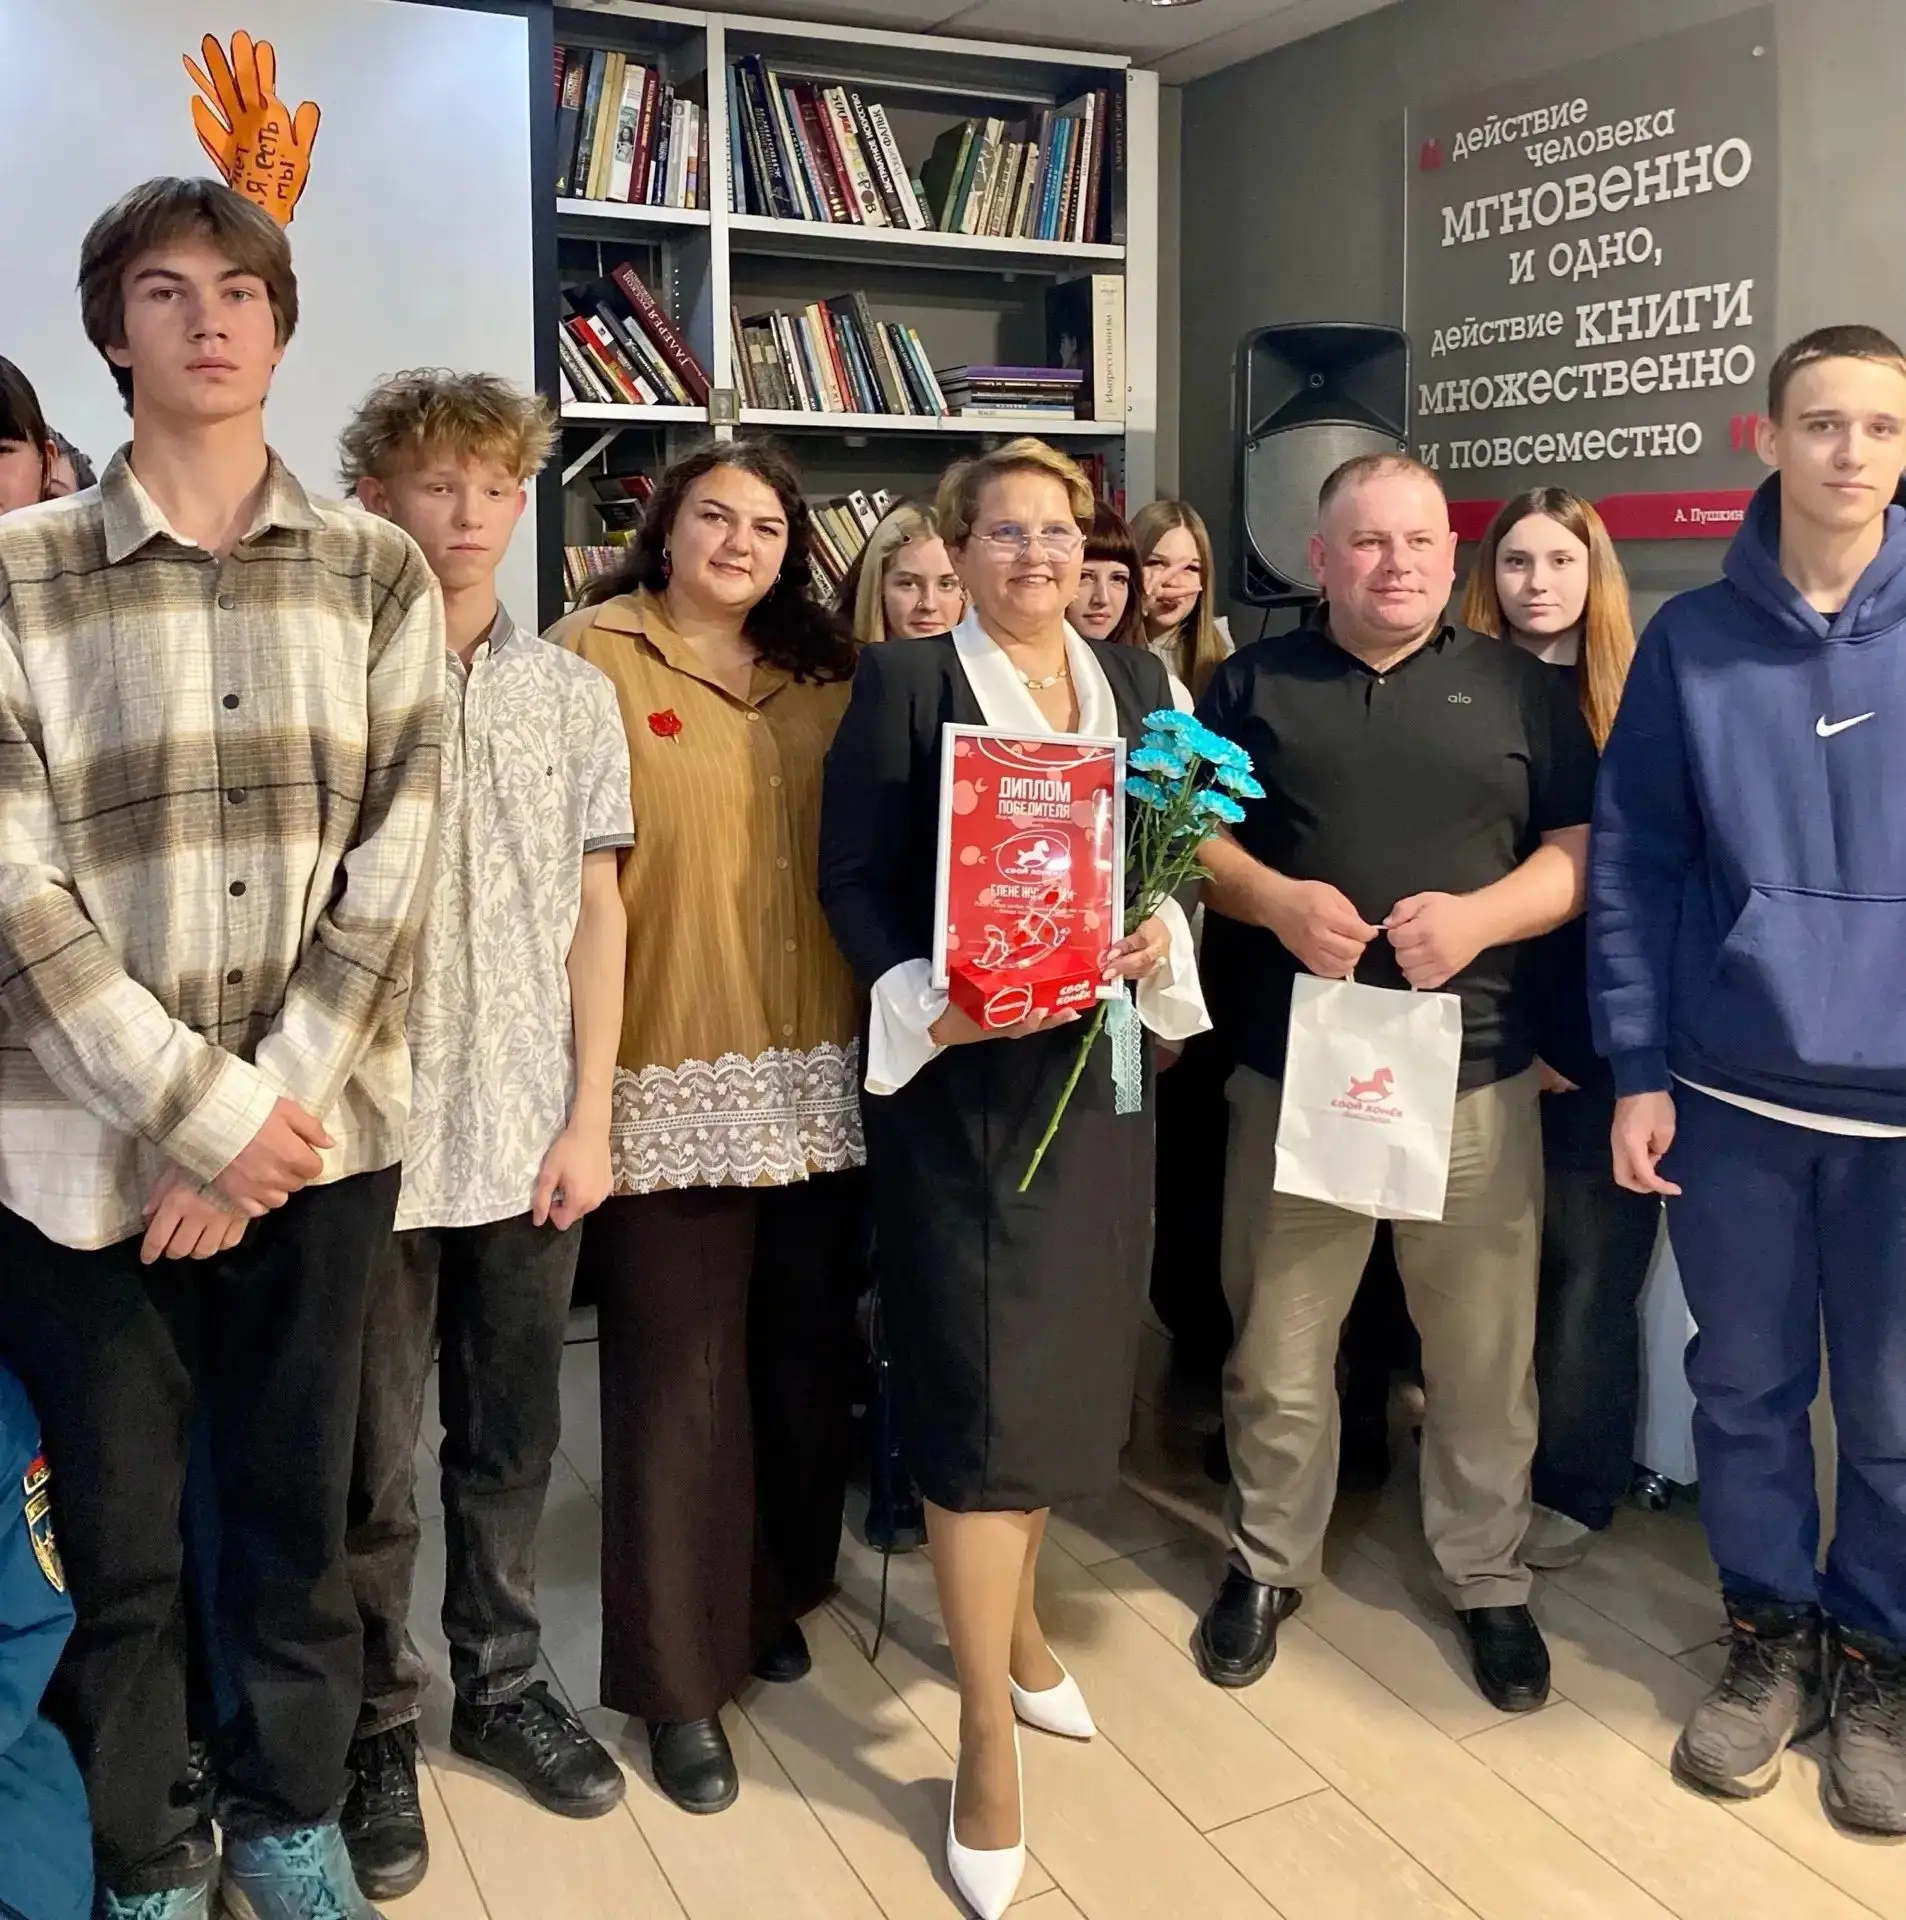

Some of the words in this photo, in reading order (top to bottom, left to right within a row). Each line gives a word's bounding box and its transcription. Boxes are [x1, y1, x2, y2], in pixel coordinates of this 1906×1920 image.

[850, 91, 874, 139] ИСКУССТВО
[870, 108, 894, 147] ФАЛЬК
[1452, 97, 1588, 161] действие
[1524, 108, 1676, 167] человека
[867, 138, 894, 194] АБСТРАКТНОЕ
[1441, 137, 1752, 246] мгновенно
[1509, 249, 1534, 284] и
[1548, 226, 1661, 281] одно,
[621, 271, 651, 311] РУССКОЙ
[646, 307, 689, 366] ГАЛЕРЕЯ
[1431, 310, 1563, 357] действие
[1103, 314, 1114, 403] Импрессионизм
[1418, 344, 1755, 415] множественно
[1419, 443, 1439, 469] и
[1450, 422, 1702, 469] повсеместно
[1674, 509, 1687, 522] А.
[1690, 508, 1744, 525] Пушкин
[1447, 692, 1472, 704] alo
[998, 777, 1071, 802] ДИПЛОМ
[999, 801, 1071, 818] ПОБЕДИТЕЛЯ
[990, 883, 1020, 898] ЕЛЕНЕ
[1059, 980, 1090, 996] СВОЙ
